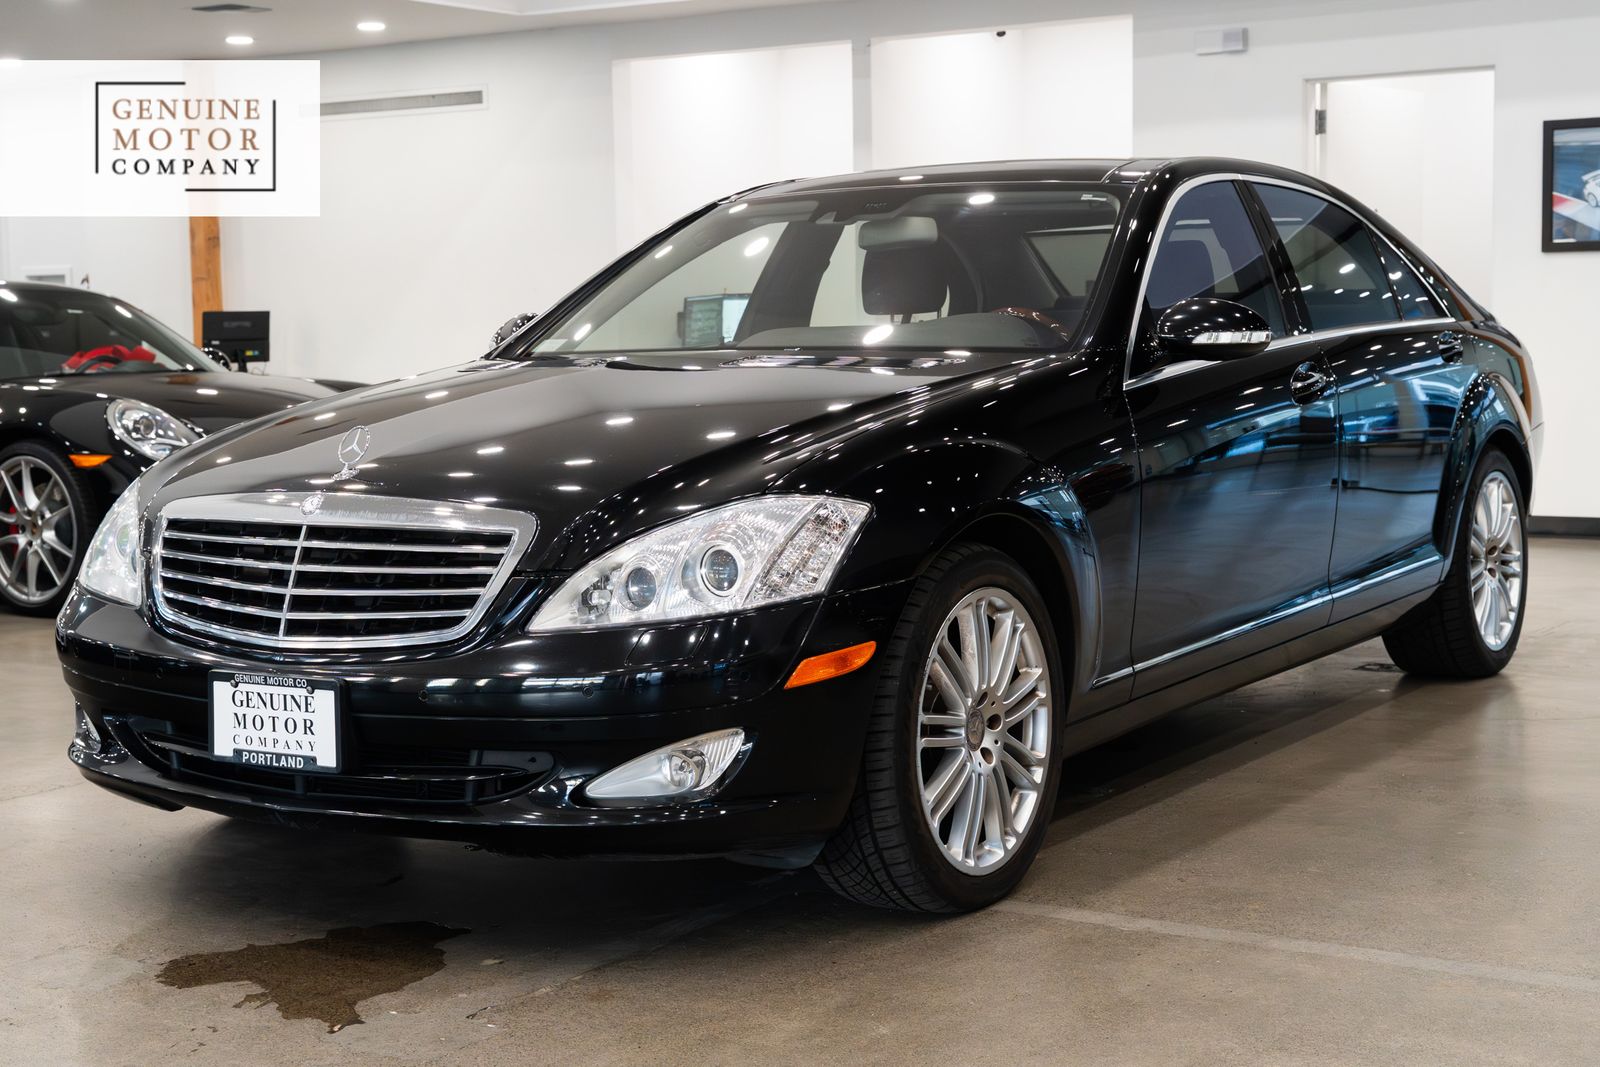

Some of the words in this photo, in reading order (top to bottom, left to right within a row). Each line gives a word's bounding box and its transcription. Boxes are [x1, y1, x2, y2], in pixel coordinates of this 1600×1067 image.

[234, 674, 266, 685] GENUINE
[266, 676, 295, 687] MOTOR
[295, 679, 308, 688] CO
[231, 689, 316, 713] GENUINE
[233, 712, 316, 736] MOTOR
[232, 734, 316, 752] COMPANY
[242, 751, 304, 769] PORTLAND
